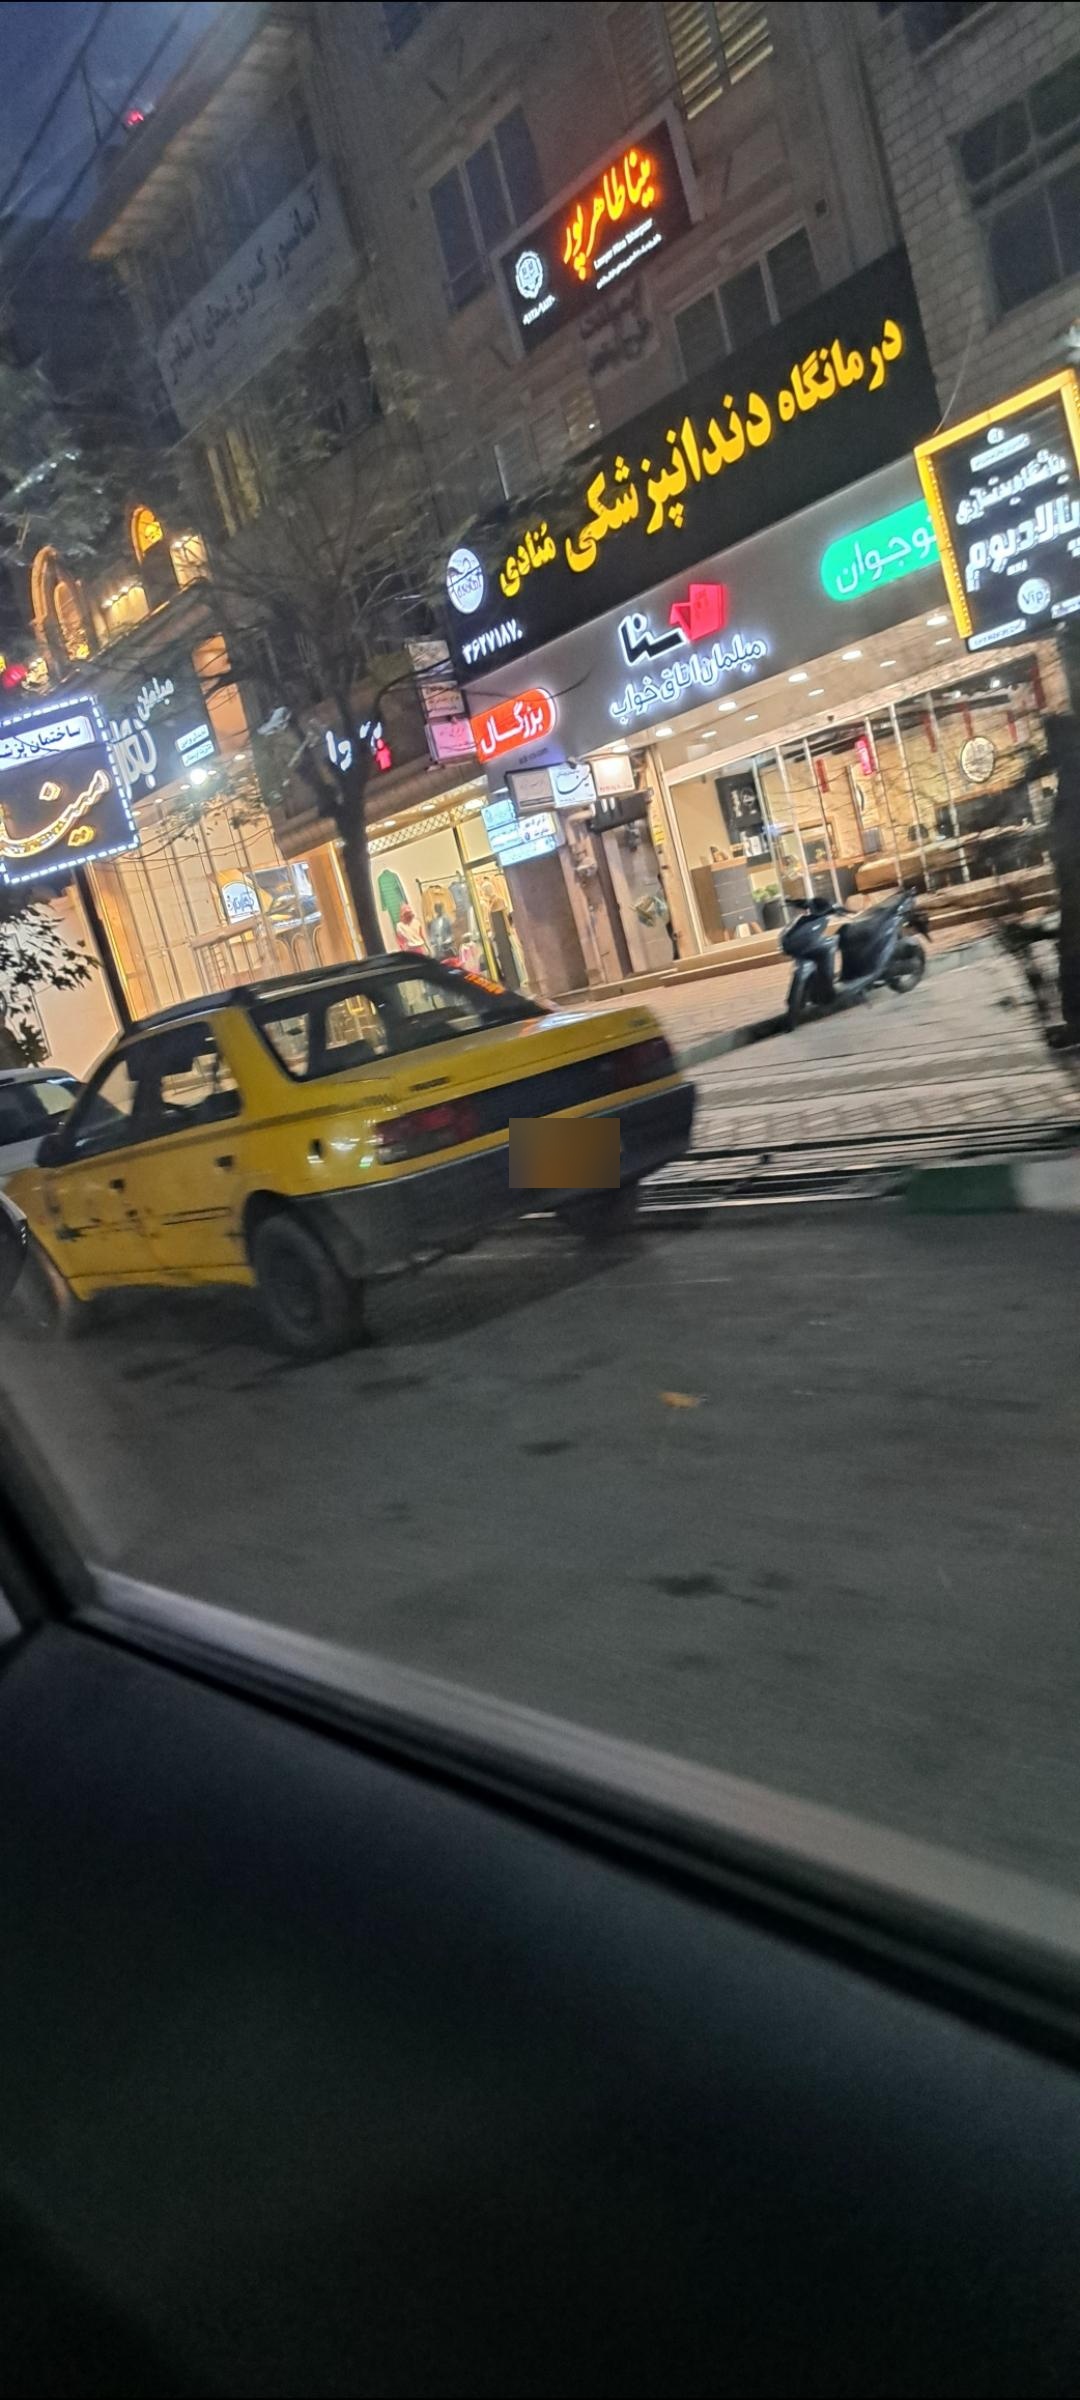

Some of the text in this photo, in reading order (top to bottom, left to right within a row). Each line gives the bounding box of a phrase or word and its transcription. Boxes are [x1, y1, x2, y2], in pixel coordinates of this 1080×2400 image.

[777, 319, 903, 422] درمانگاه
[564, 391, 772, 573] دندانپزشکی
[700, 633, 768, 687] مبلمان
[609, 675, 660, 726] خواب
[31, 724, 82, 754] ساختمان
